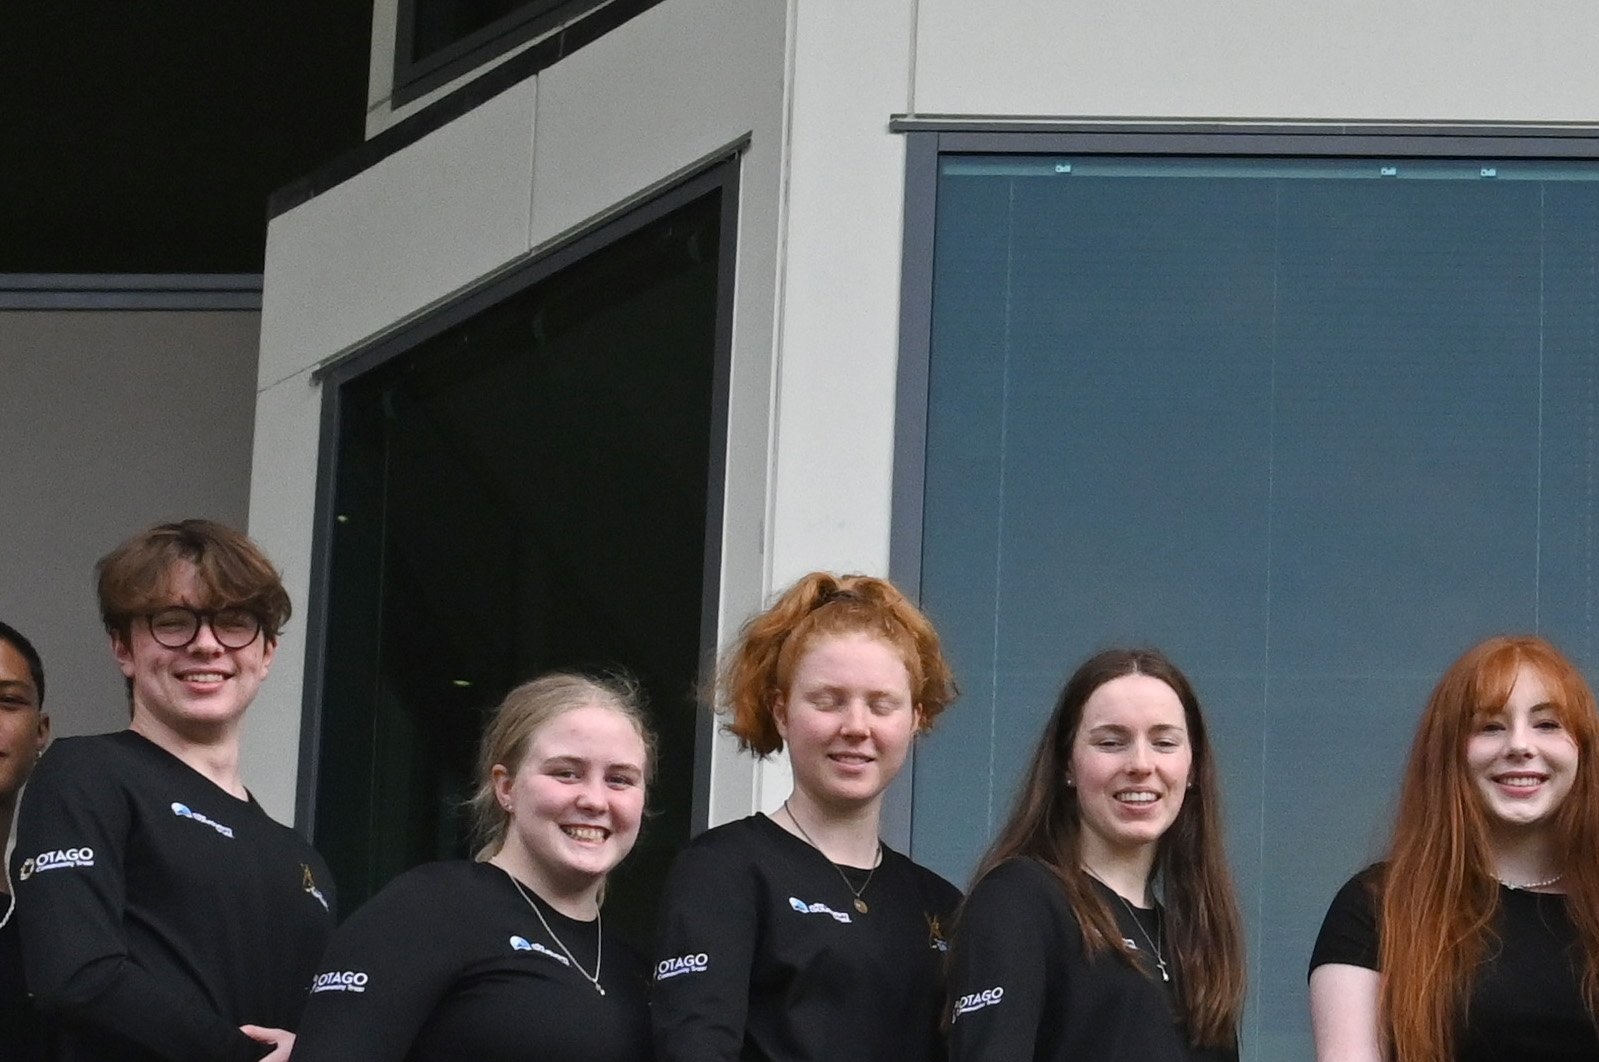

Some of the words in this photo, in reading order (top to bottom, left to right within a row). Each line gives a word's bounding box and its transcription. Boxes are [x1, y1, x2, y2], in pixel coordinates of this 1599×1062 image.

[35, 847, 94, 867] OTAGO
[658, 953, 709, 974] OTAGO
[318, 971, 368, 986] OTAGO
[959, 986, 1004, 1009] OTAGO
